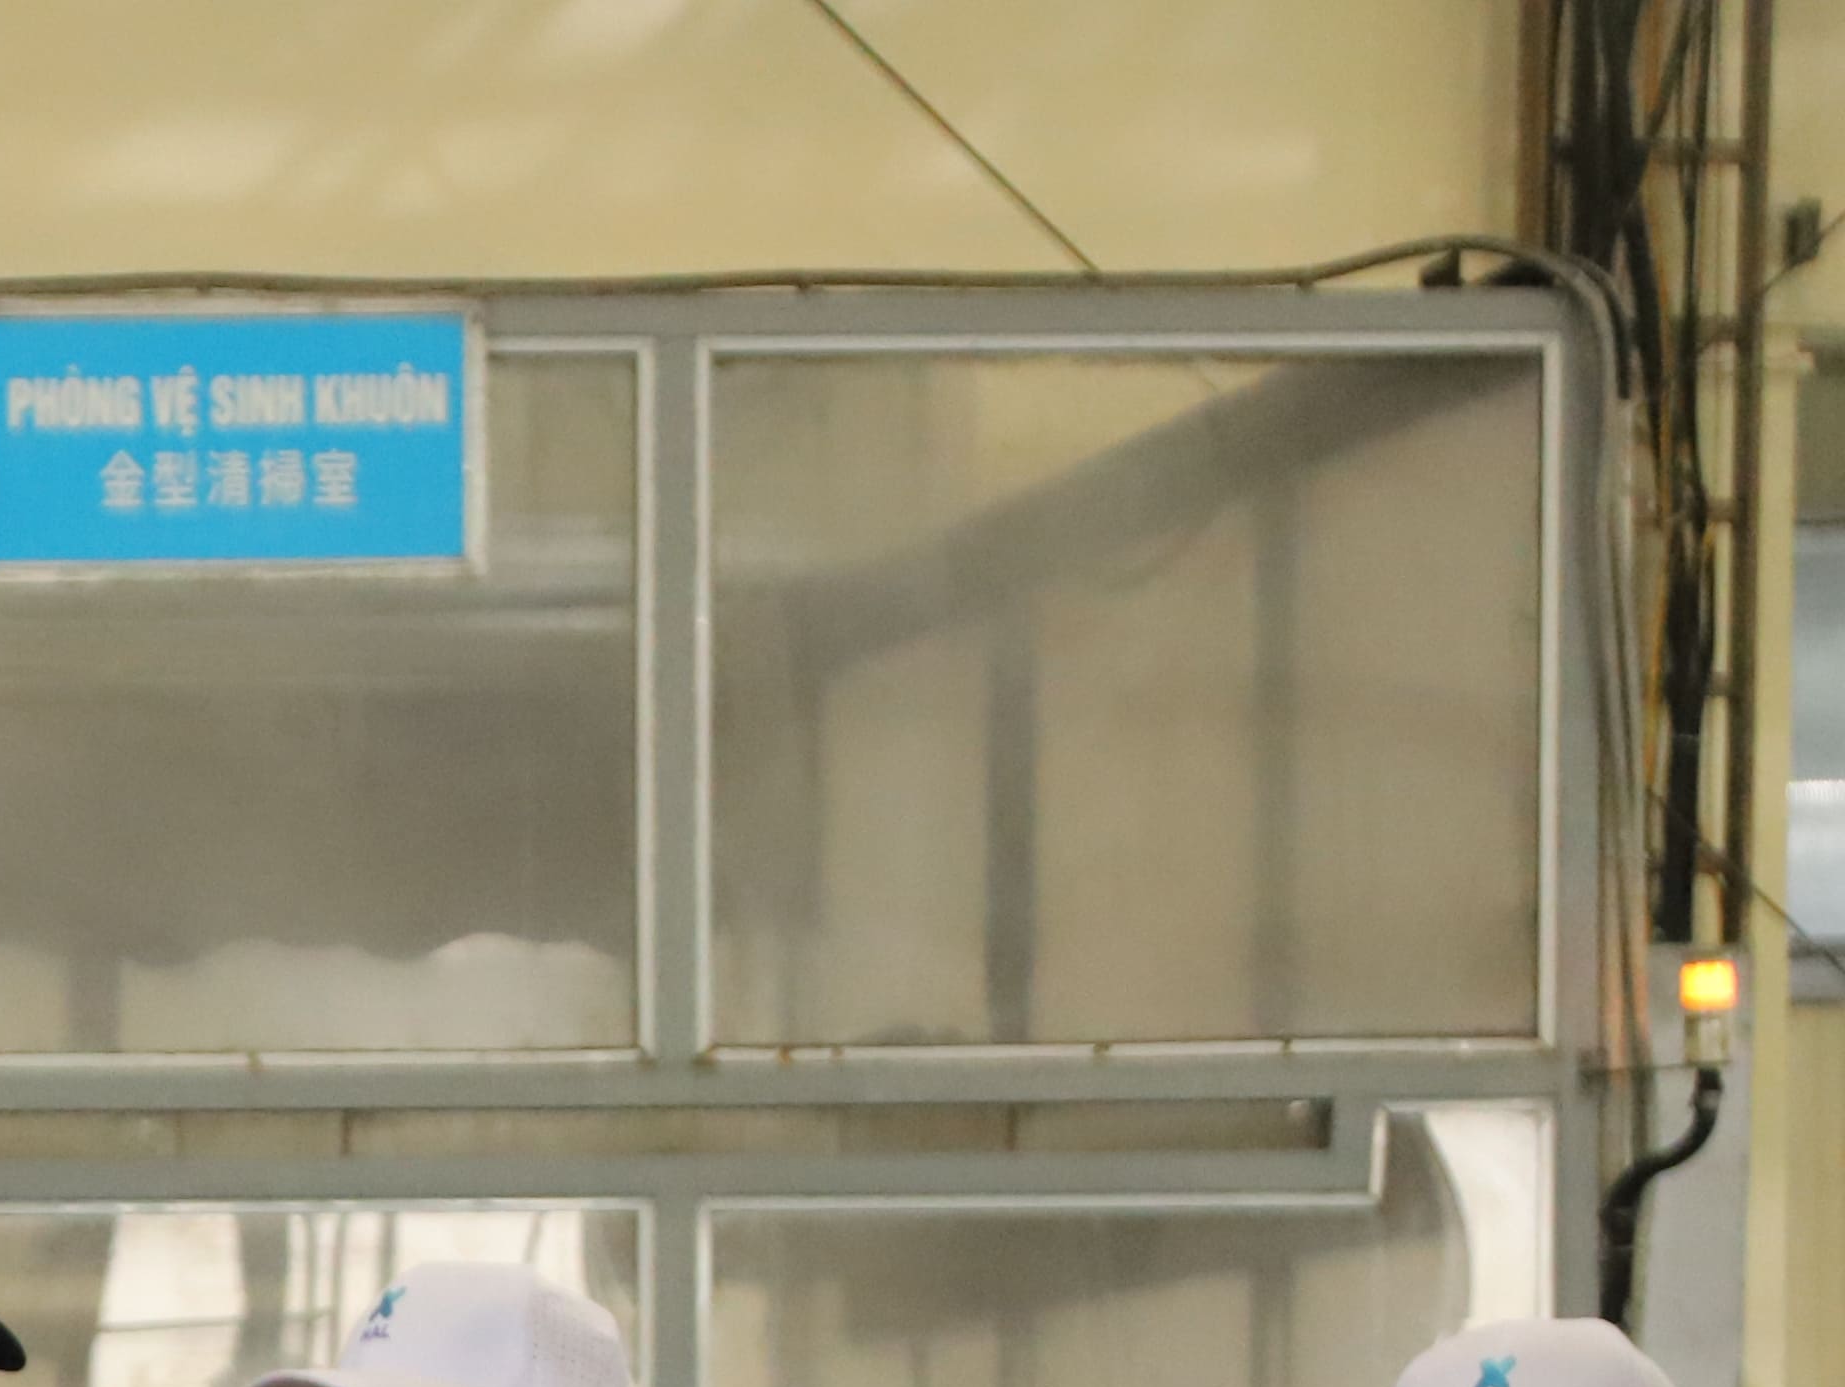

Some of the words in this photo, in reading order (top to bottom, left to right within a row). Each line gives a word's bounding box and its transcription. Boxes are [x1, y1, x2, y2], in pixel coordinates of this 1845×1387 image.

[7, 364, 142, 428] PHÒNG
[151, 364, 199, 437] VỆ
[209, 374, 306, 425] SINH
[313, 361, 449, 424] KHUÔN
